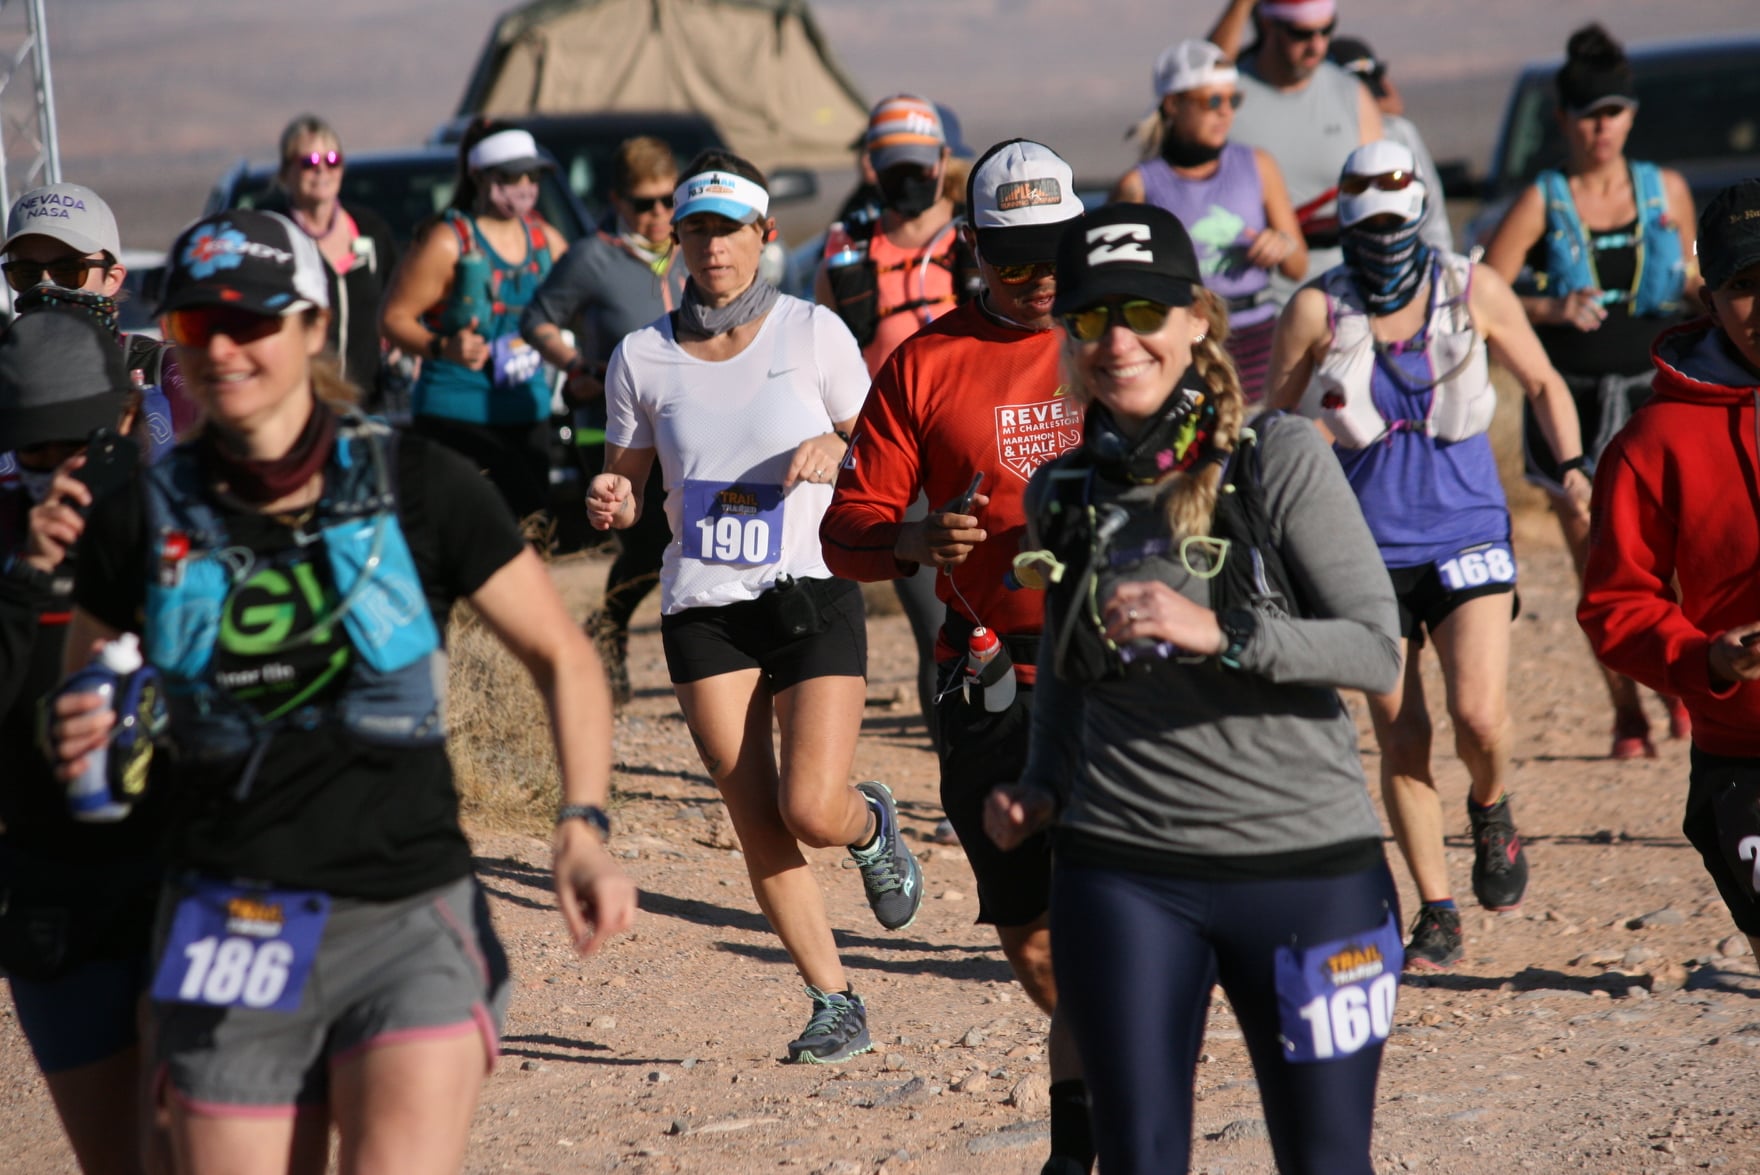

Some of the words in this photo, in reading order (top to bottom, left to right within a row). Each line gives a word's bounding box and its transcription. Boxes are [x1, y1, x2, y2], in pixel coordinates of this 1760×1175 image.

[19, 194, 87, 212] NEVADA
[27, 207, 70, 220] NASA
[1001, 402, 1078, 427] REVEL
[1003, 426, 1017, 435] MT
[1020, 416, 1080, 433] CHARLESTON
[1003, 431, 1055, 446] MARATHON
[1004, 446, 1016, 457] &
[1019, 440, 1056, 456] HALF
[720, 490, 758, 506] TRAIL
[696, 516, 770, 563] 190
[1440, 548, 1515, 590] 168
[1328, 944, 1384, 974] TRAIL
[179, 936, 294, 1007] 186
[1299, 973, 1397, 1059] 160
